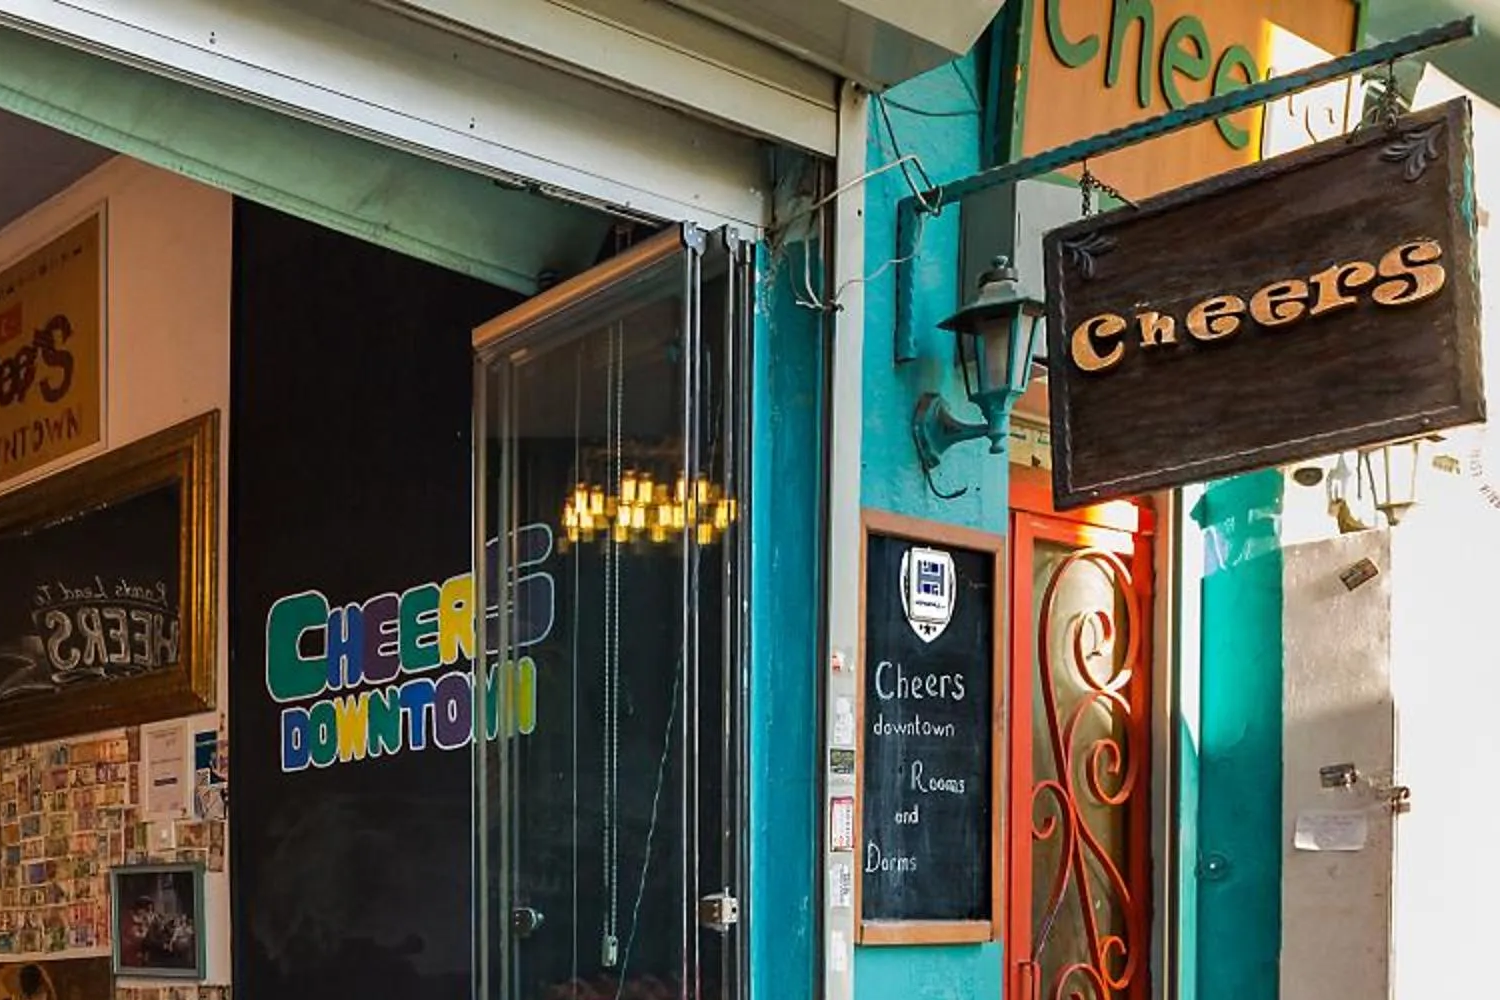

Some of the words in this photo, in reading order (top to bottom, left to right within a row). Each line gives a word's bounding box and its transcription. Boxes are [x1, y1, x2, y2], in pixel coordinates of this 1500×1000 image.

[1071, 240, 1446, 372] Cheers
[266, 523, 555, 702] CHEERS
[875, 661, 966, 701] Cheers
[873, 714, 956, 737] downtown
[911, 760, 966, 793] Rooms
[895, 805, 919, 824] and
[865, 840, 918, 872] Dorms
